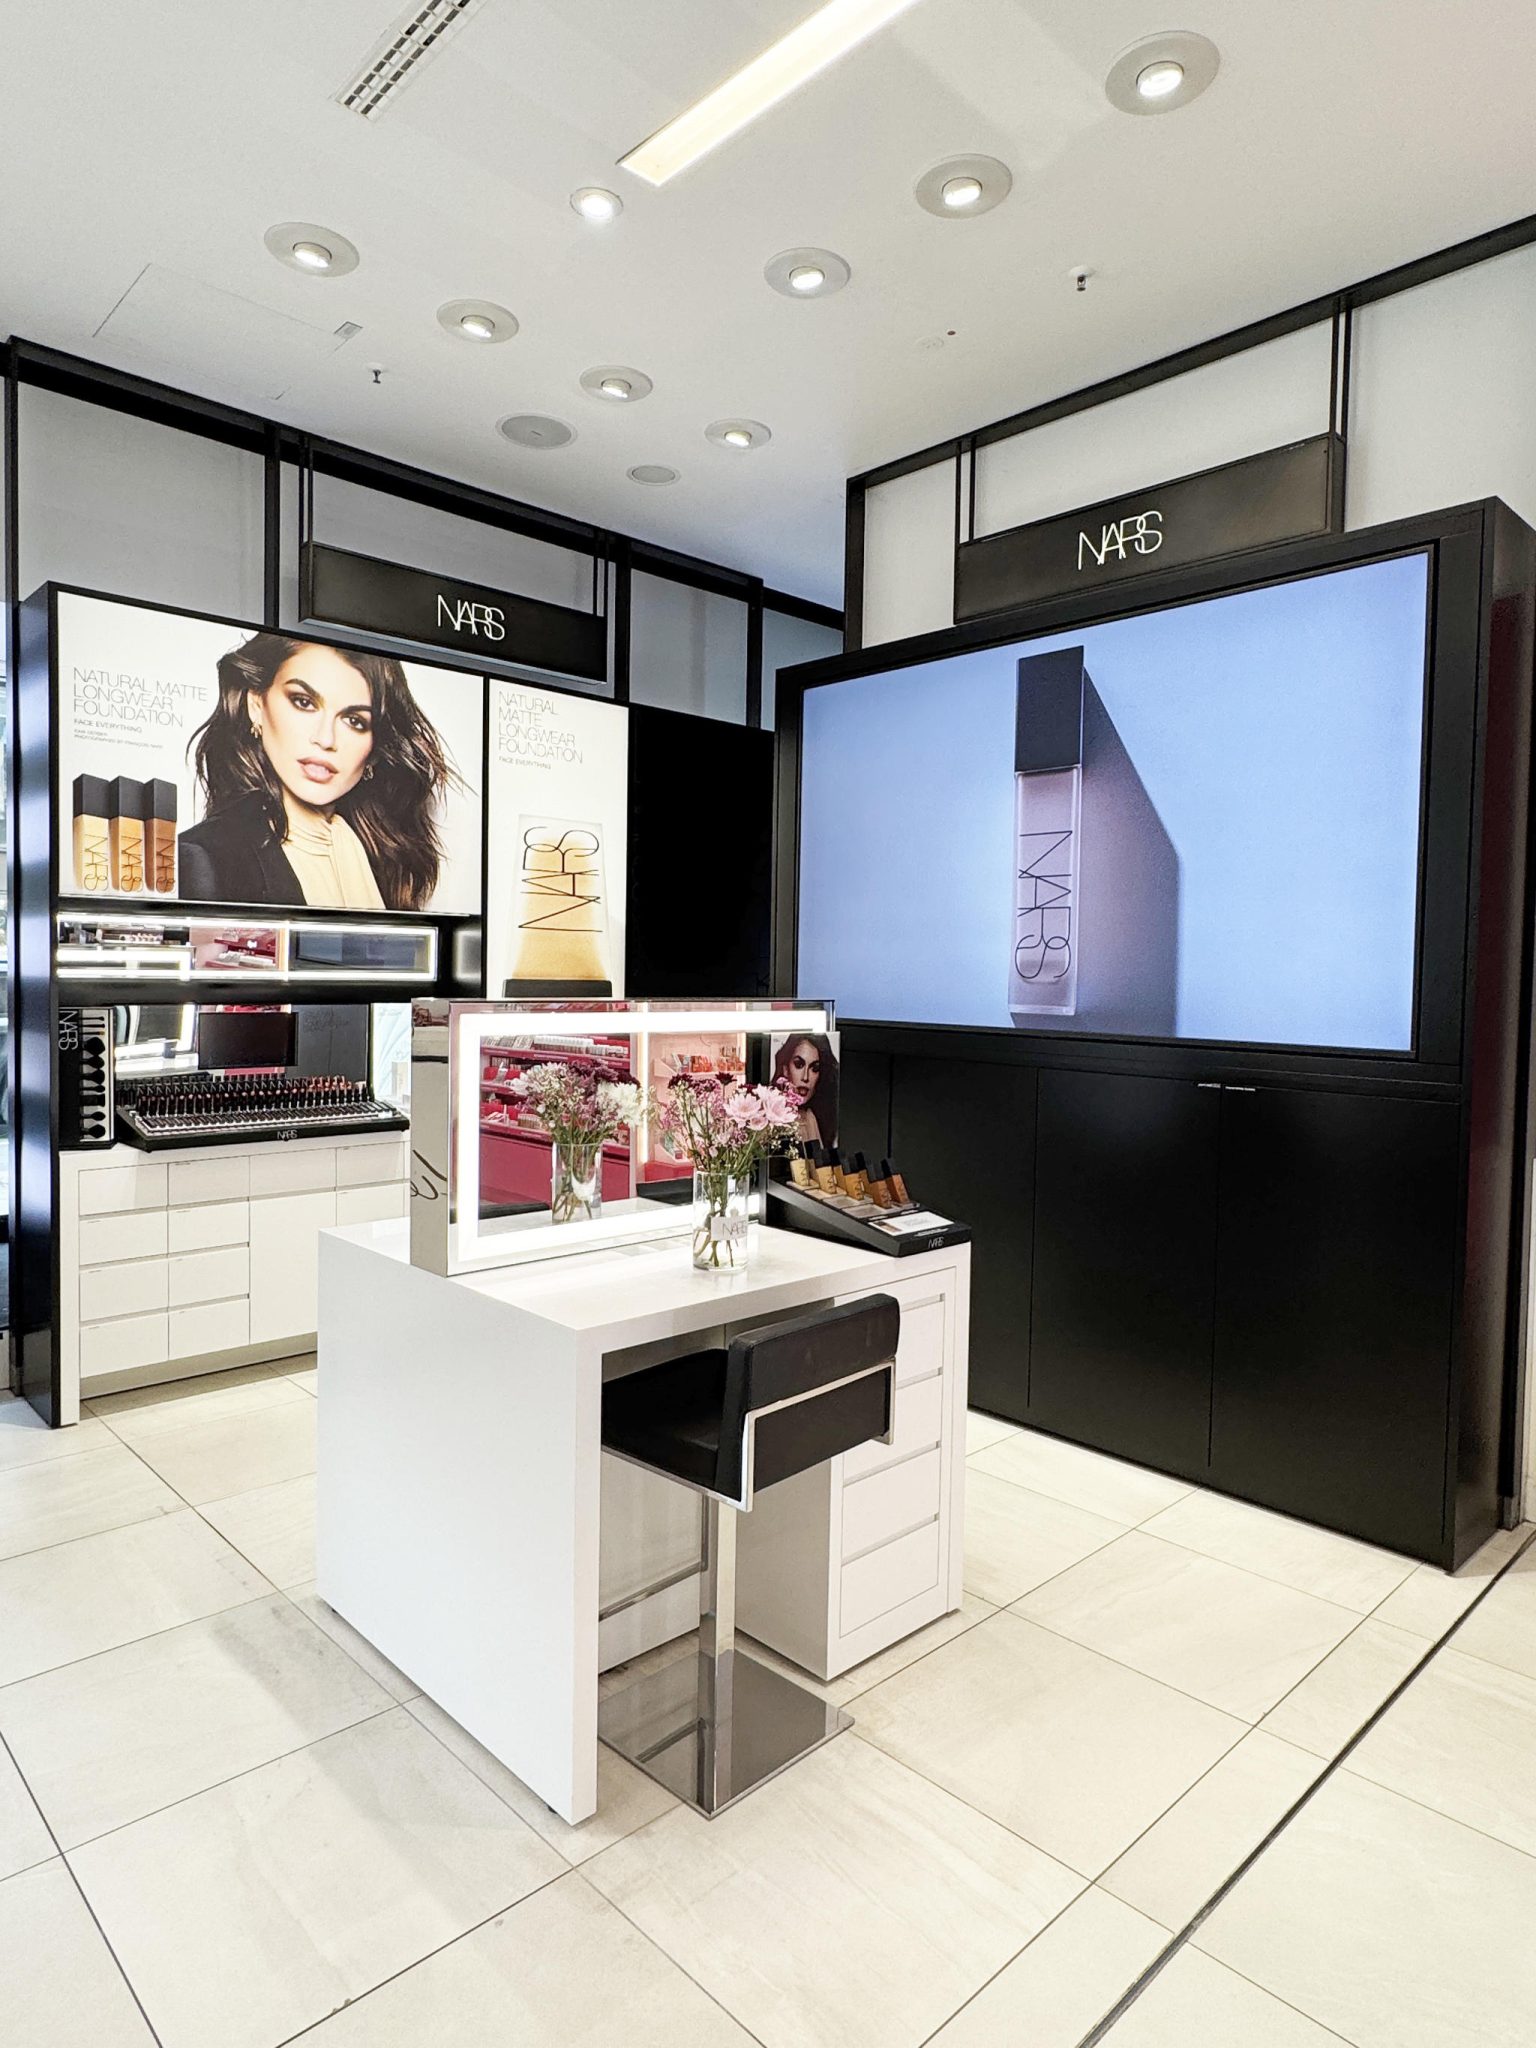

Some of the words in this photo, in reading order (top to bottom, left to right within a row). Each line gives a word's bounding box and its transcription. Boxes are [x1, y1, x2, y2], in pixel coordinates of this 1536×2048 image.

[1078, 510, 1163, 571] NARS
[437, 594, 506, 641] NARS
[73, 666, 152, 693] NATURAL
[156, 680, 208, 701] MATTE
[73, 683, 174, 711] LONGWEAR
[73, 699, 184, 728] FOUNDATION
[498, 690, 561, 716] NATURAL
[498, 706, 545, 728] MATTE
[74, 718, 95, 727] FACE
[498, 722, 576, 748] LONGWEAR
[498, 736, 584, 764] FOUNDATION
[83, 833, 109, 892] NARS
[120, 835, 144, 893] NARS
[155, 837, 176, 894] NARS
[518, 825, 604, 933] NARS
[1014, 830, 1074, 980] NARS
[58, 1010, 79, 1051] NARS
